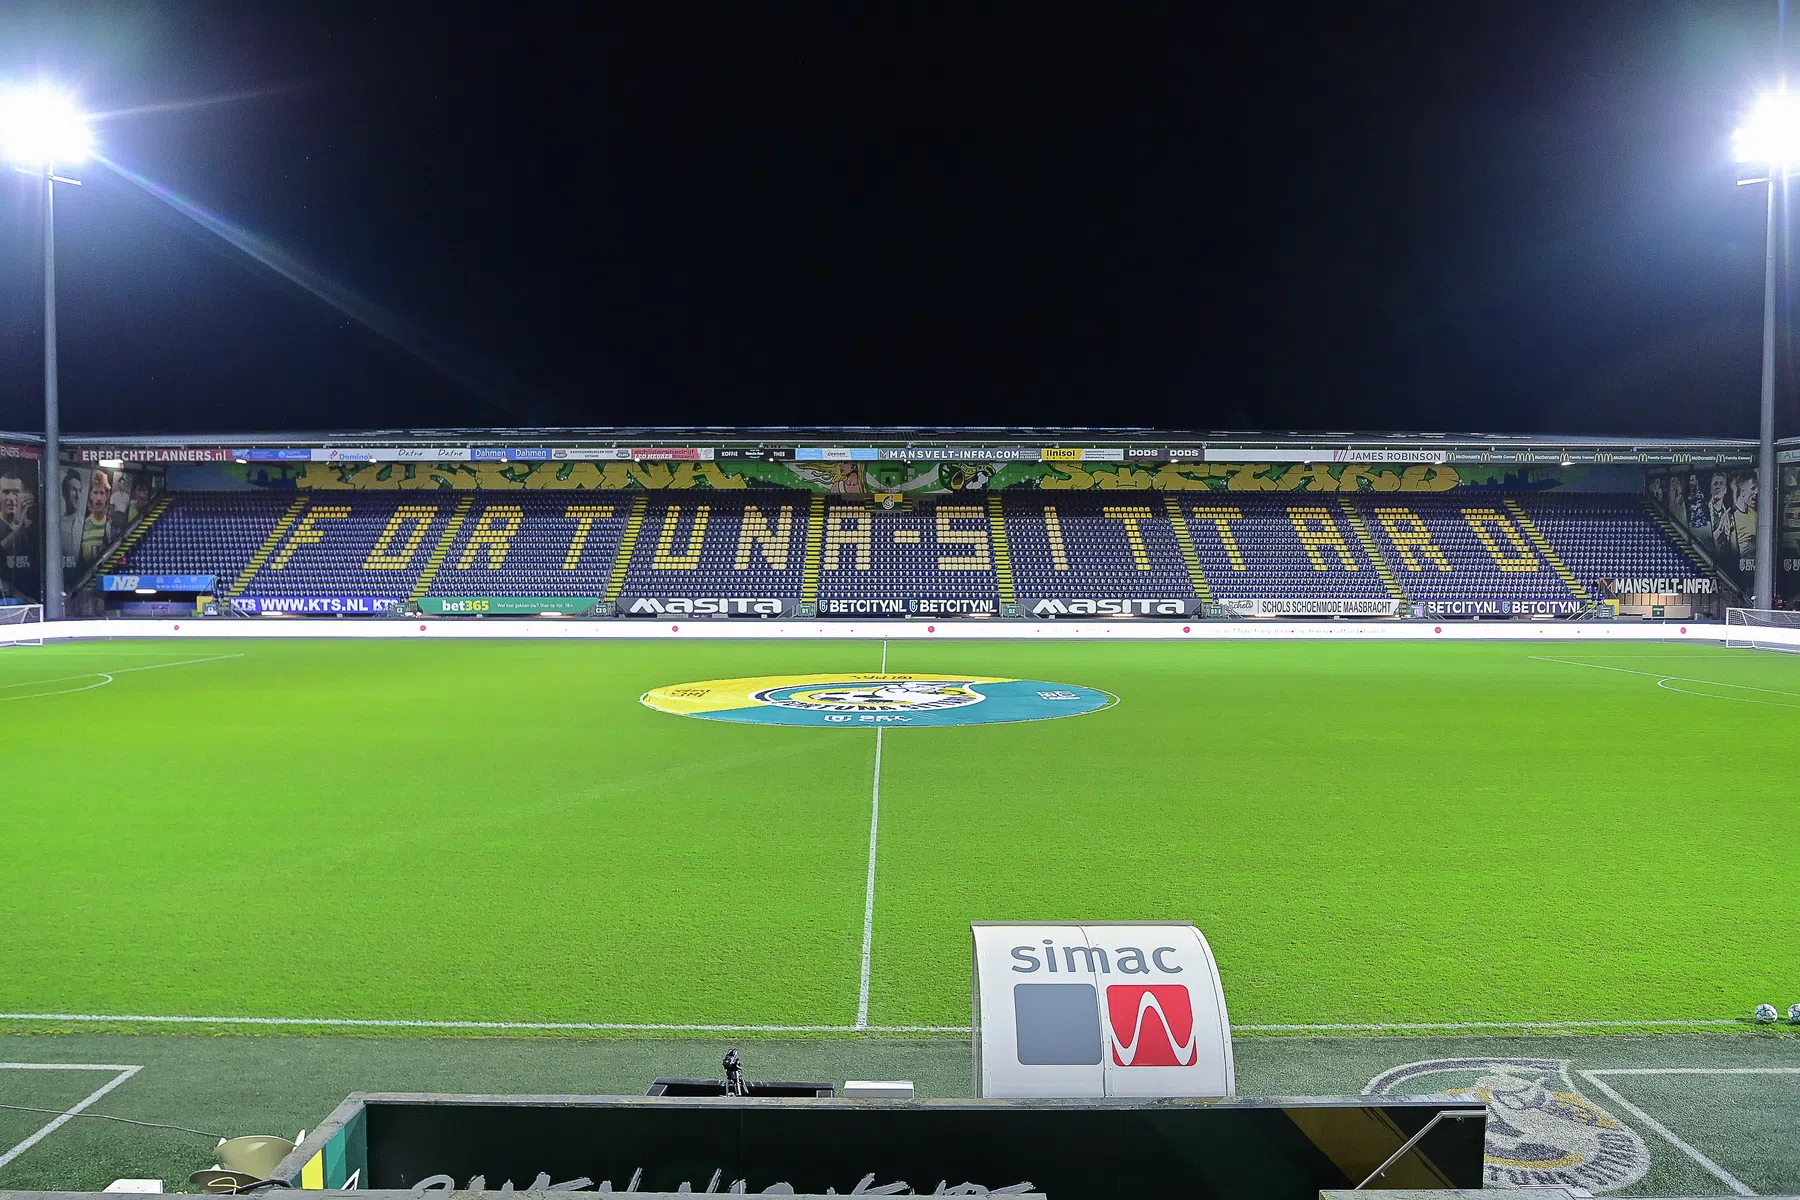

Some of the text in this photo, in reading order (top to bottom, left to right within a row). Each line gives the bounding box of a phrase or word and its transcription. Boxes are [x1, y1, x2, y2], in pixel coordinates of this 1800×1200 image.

[82, 450, 227, 461] ERFRECHTPLANNERS.nl
[475, 449, 506, 457] Dahmen
[515, 449, 547, 457] Dahmen
[889, 450, 1019, 459] MANSVELT-INFRA.COM
[1046, 449, 1075, 457] linisol
[1350, 452, 1441, 460] JAMES ROBINSON
[111, 575, 140, 591] NB
[1614, 578, 1719, 594] MANSVELT-INFRA
[260, 598, 368, 611] WWW.KTS.NL
[442, 600, 489, 611] bet365
[829, 600, 907, 613] BETCITY.NL
[920, 600, 998, 613] BETCITY.NL
[1262, 600, 1392, 613] SCHOLS SCHOENMODE MAASBRACHT
[1427, 601, 1500, 613] BETCITY.NL
[1512, 601, 1584, 613] BETCITY.NL
[1010, 939, 1184, 975] simac
